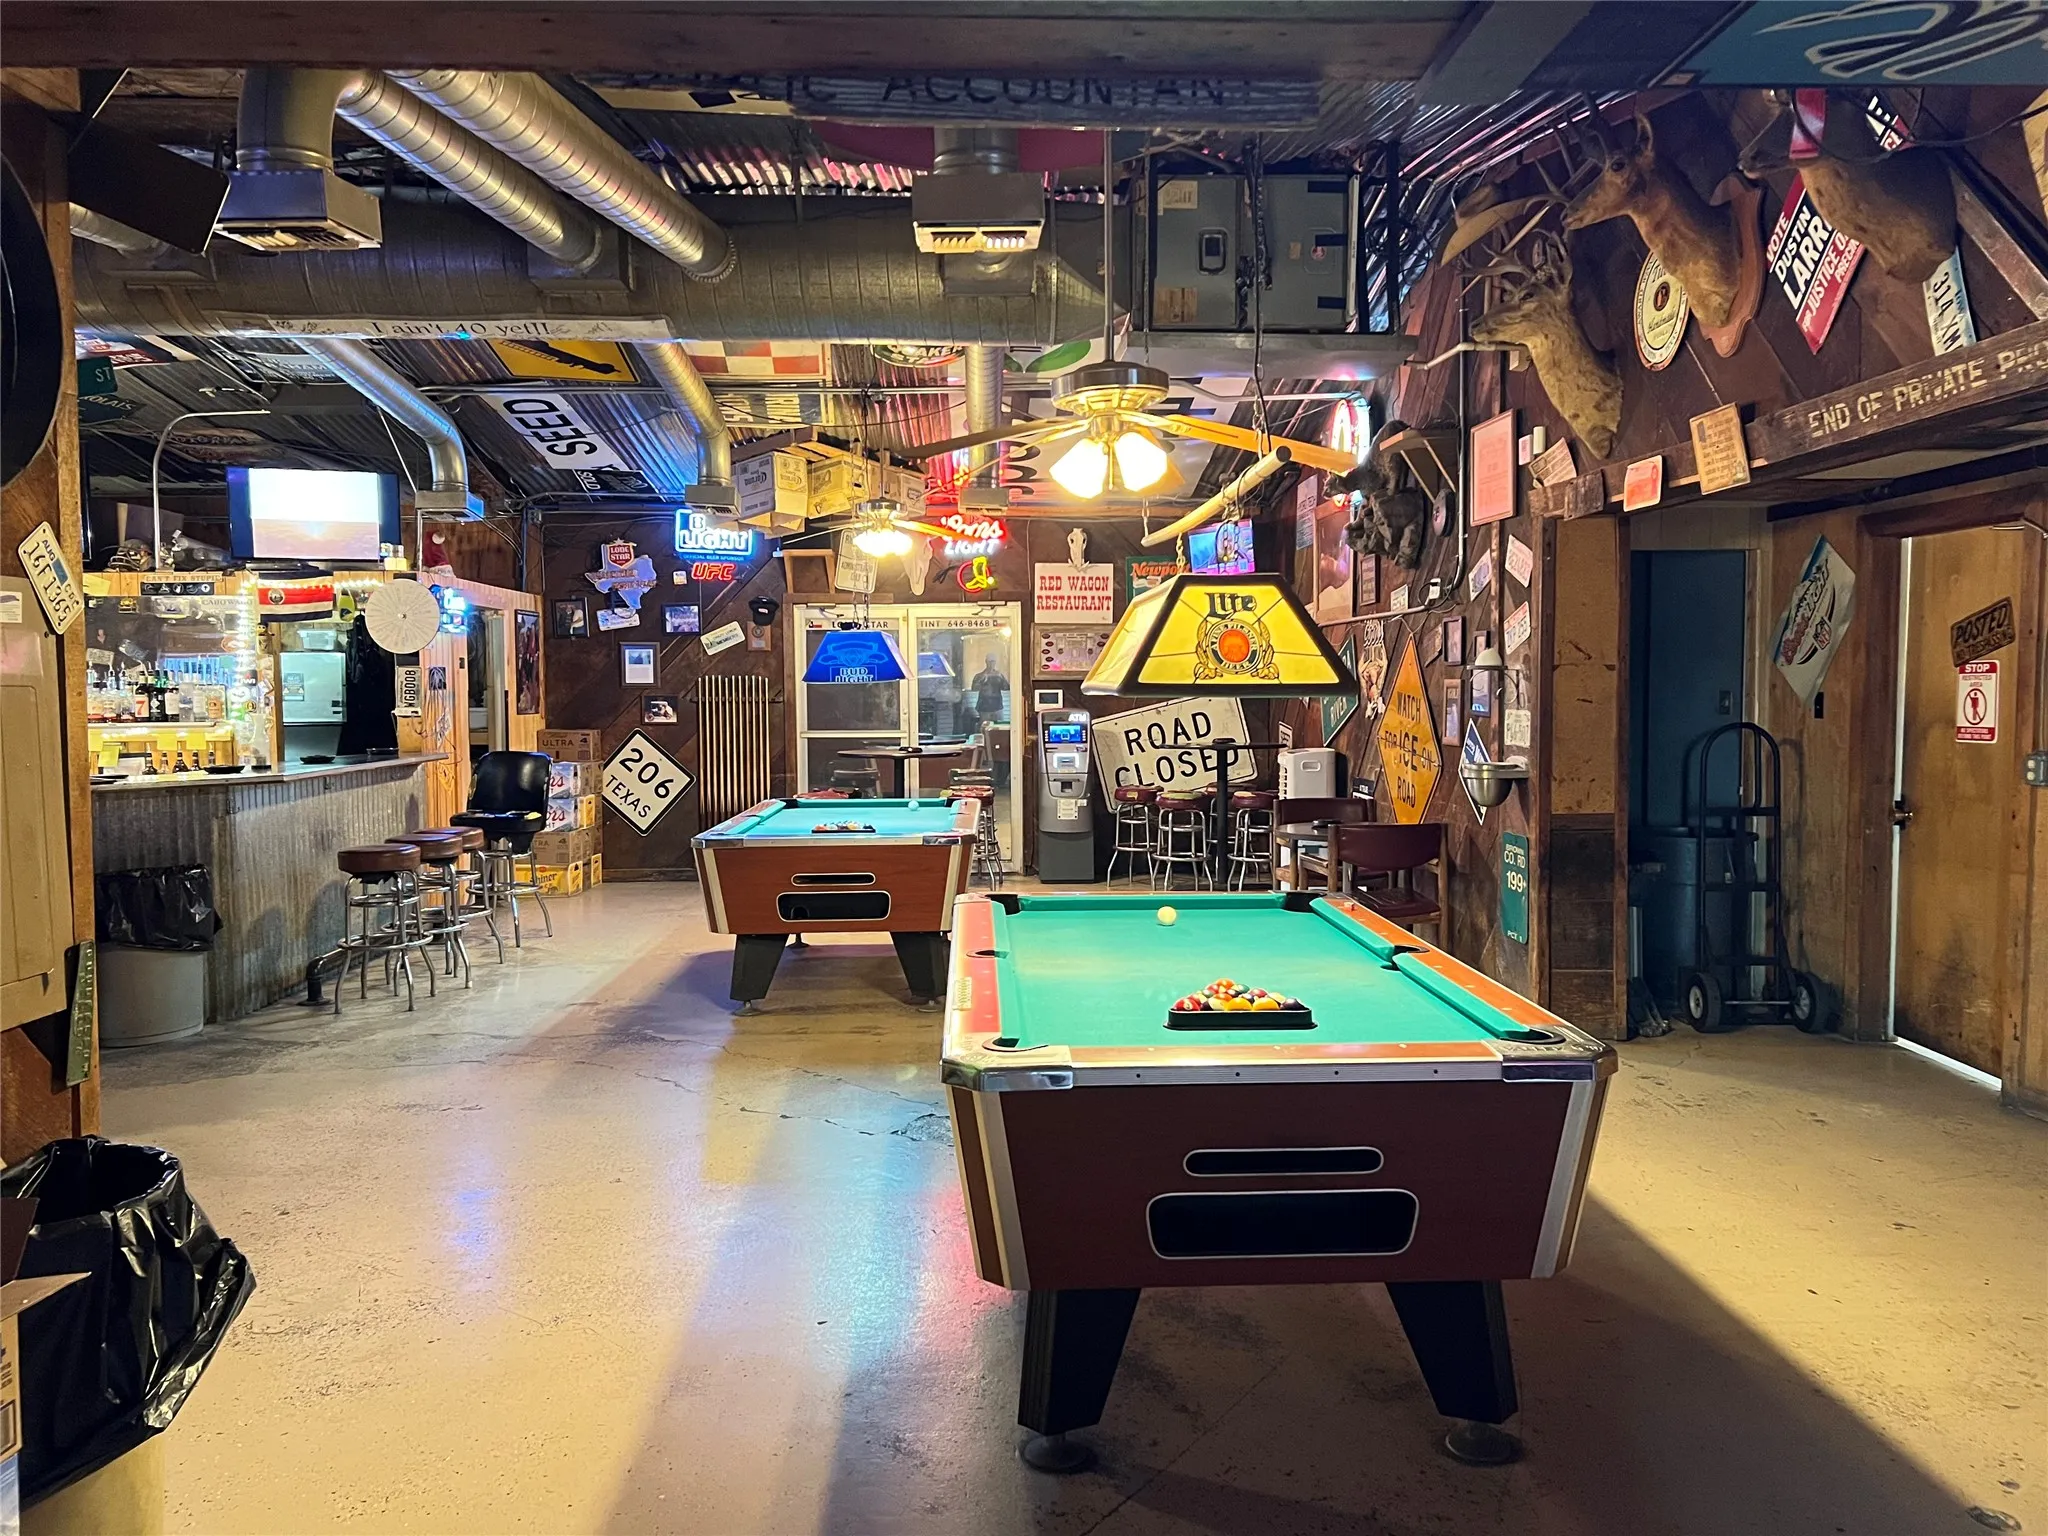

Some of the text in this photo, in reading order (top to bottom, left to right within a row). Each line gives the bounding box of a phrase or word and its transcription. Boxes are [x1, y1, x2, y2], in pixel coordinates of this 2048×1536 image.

[1766, 211, 1790, 263] VOTE
[1774, 205, 1811, 283] DUSTIN
[1783, 215, 1832, 310] LARR
[1807, 244, 1841, 315] JUSTICE
[1835, 231, 1849, 251] O
[392, 322, 443, 335] ain't
[887, 344, 964, 357] QAKER
[95, 366, 111, 382] ST
[1808, 403, 1851, 438] END
[1857, 391, 1883, 423] OF
[502, 398, 599, 465] SEED
[577, 470, 601, 490] SOLD
[42, 539, 56, 562] AUG
[944, 539, 1000, 555] LIGHT
[691, 562, 735, 580] UFC
[1039, 575, 1110, 592] RED WAGON
[1037, 595, 1112, 611] RESTAURANT
[1955, 605, 2009, 645] POSTED
[840, 667, 868, 676] BUD
[1964, 663, 1991, 673] STOP
[135, 701, 145, 715] 7
[1068, 713, 1087, 721] ATM
[1397, 691, 1421, 724] WATCH
[542, 739, 574, 747] ULTRA
[1124, 711, 1212, 756] ROAD
[1384, 729, 1432, 772] FOR ICE ON
[618, 747, 675, 799] 206
[605, 774, 652, 818] TEXAS
[1397, 776, 1416, 808] ROAD
[1516, 854, 1526, 869] RD
[529, 872, 558, 884] hiner
